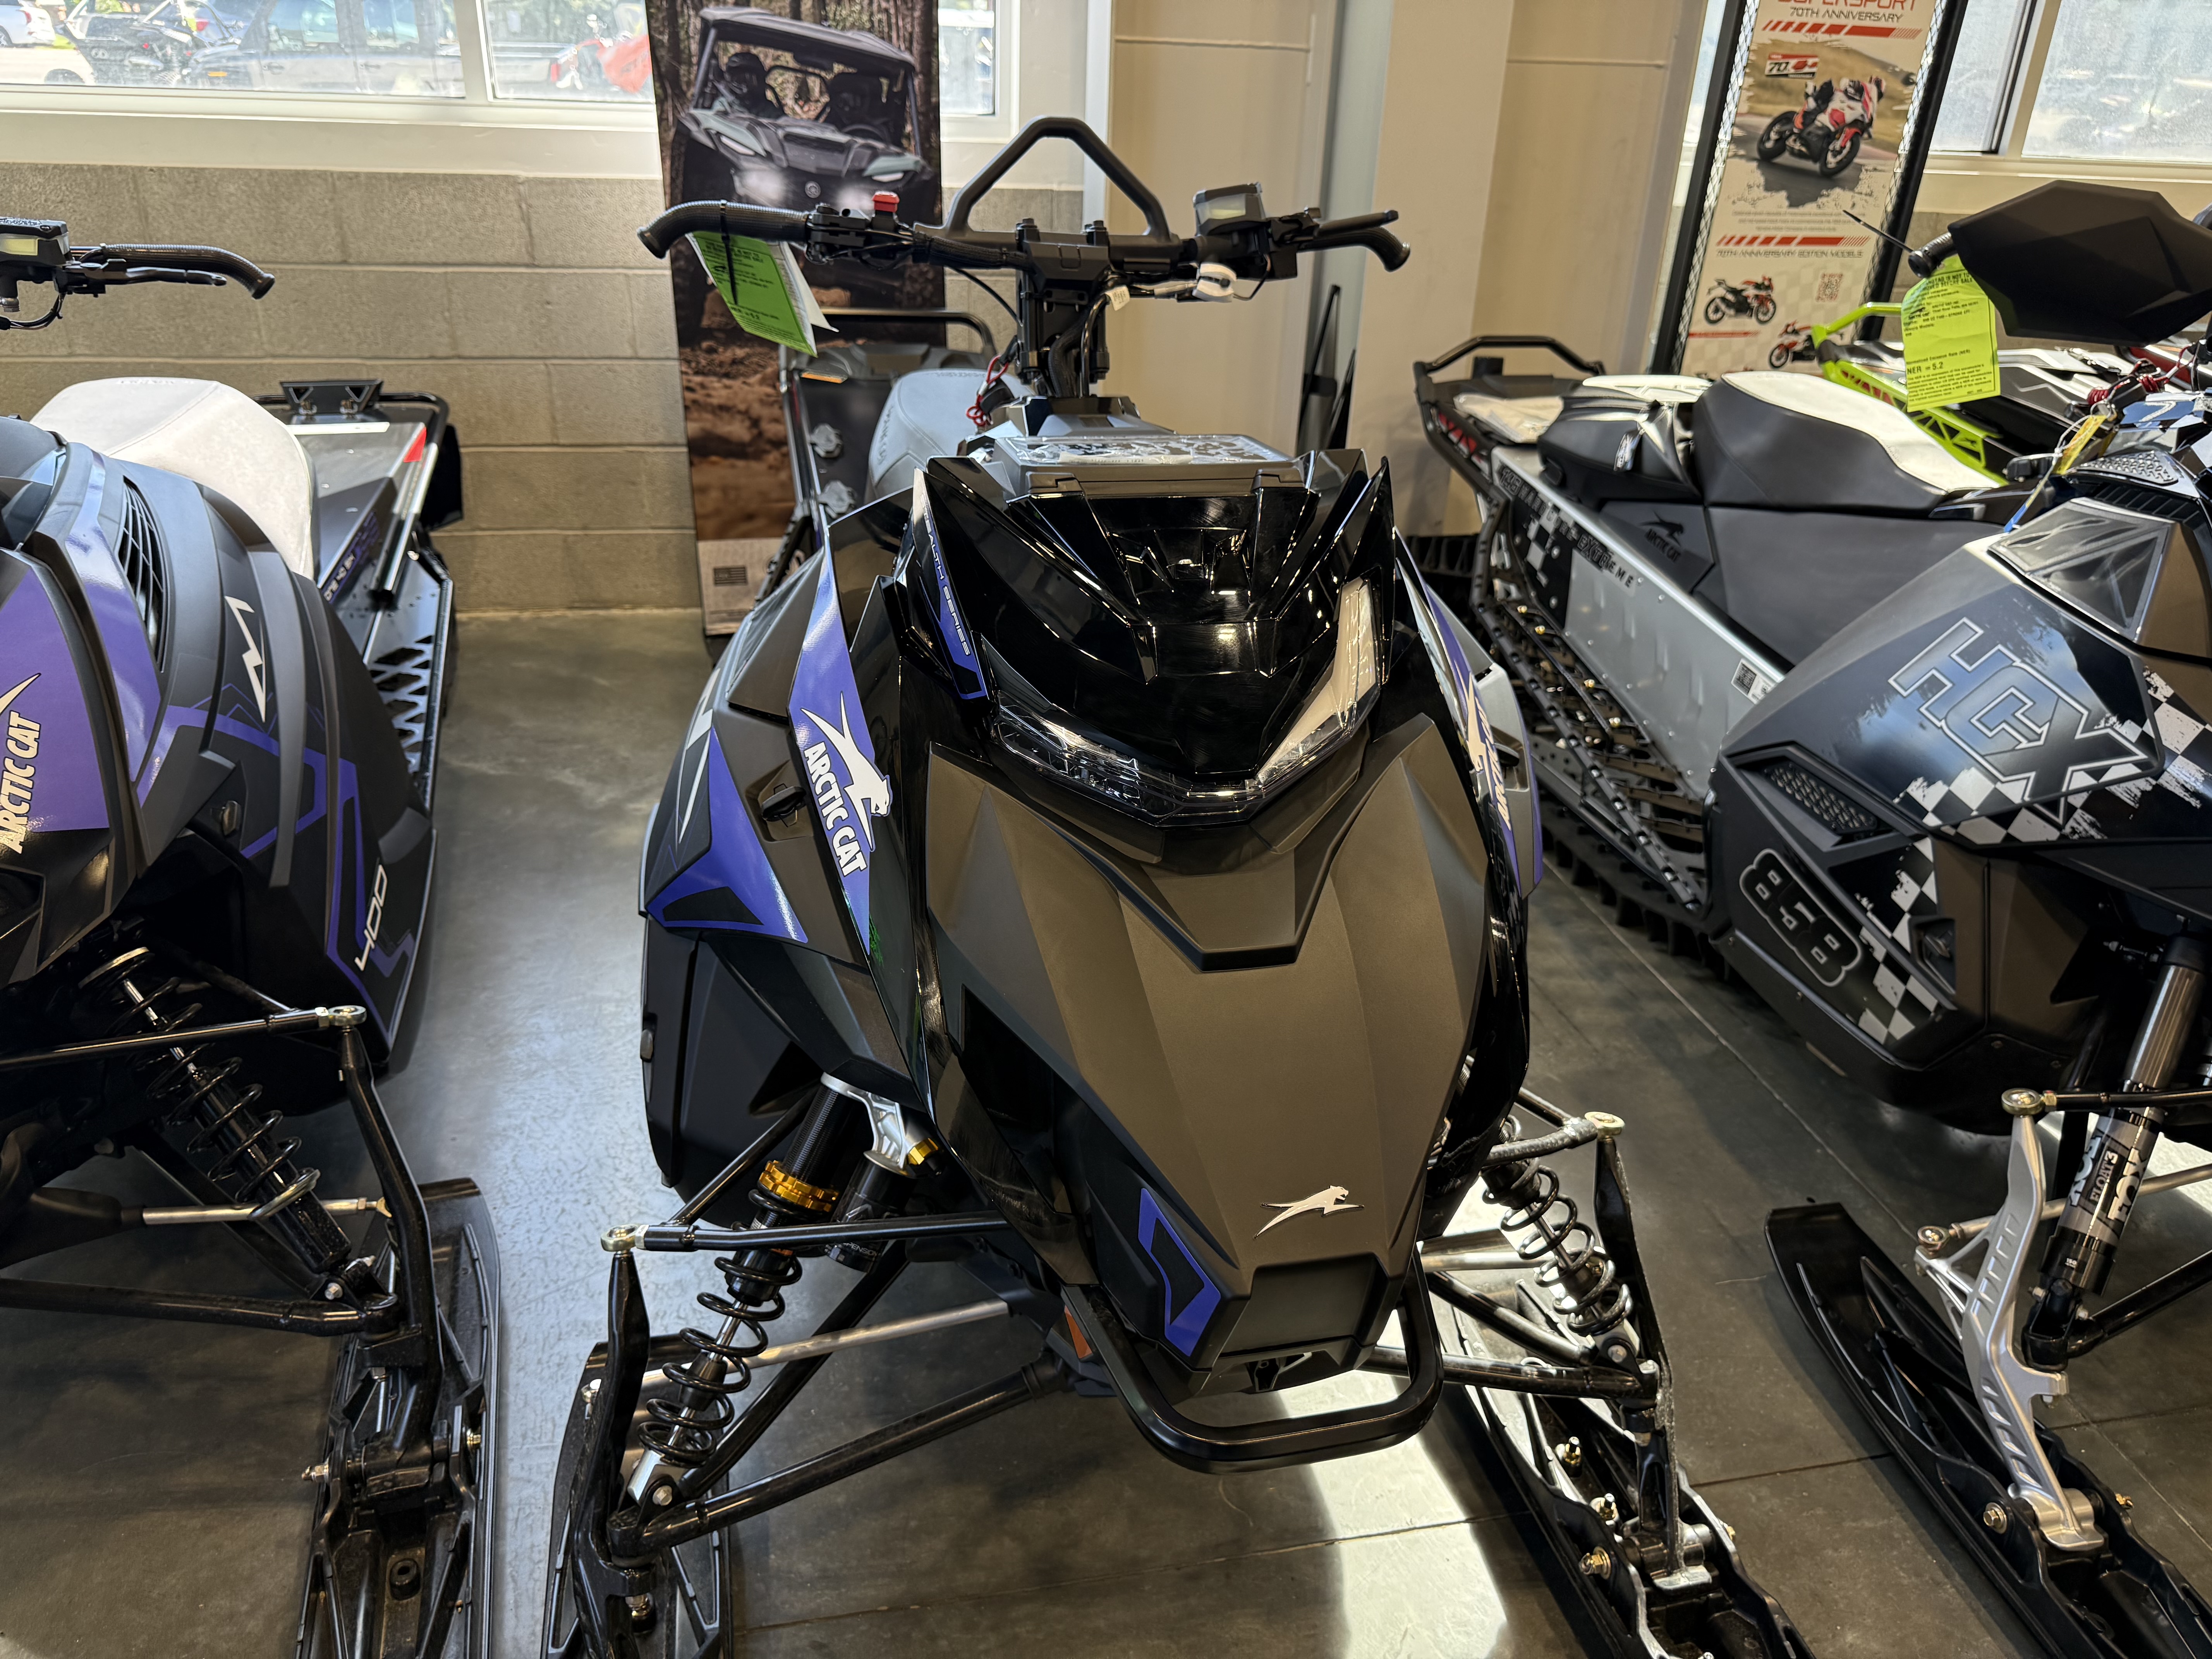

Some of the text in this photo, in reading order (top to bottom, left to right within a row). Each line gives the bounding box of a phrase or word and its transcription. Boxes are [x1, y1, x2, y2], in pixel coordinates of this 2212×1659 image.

[1790, 7, 1903, 22] 70TH ANNIVERSARY
[1907, 366, 1922, 374] NER
[1932, 361, 1943, 370] 5.2
[1576, 532, 1635, 588] EXTREME
[943, 586, 970, 656] SERIES
[1888, 617, 2148, 828] HCX
[0, 711, 41, 854] ARCTIC CAT
[804, 741, 867, 877] ARCTIC CAT
[354, 864, 387, 971] 400
[2090, 1162, 2113, 1201] FLOAT
[2107, 1147, 2148, 1222] FOX
